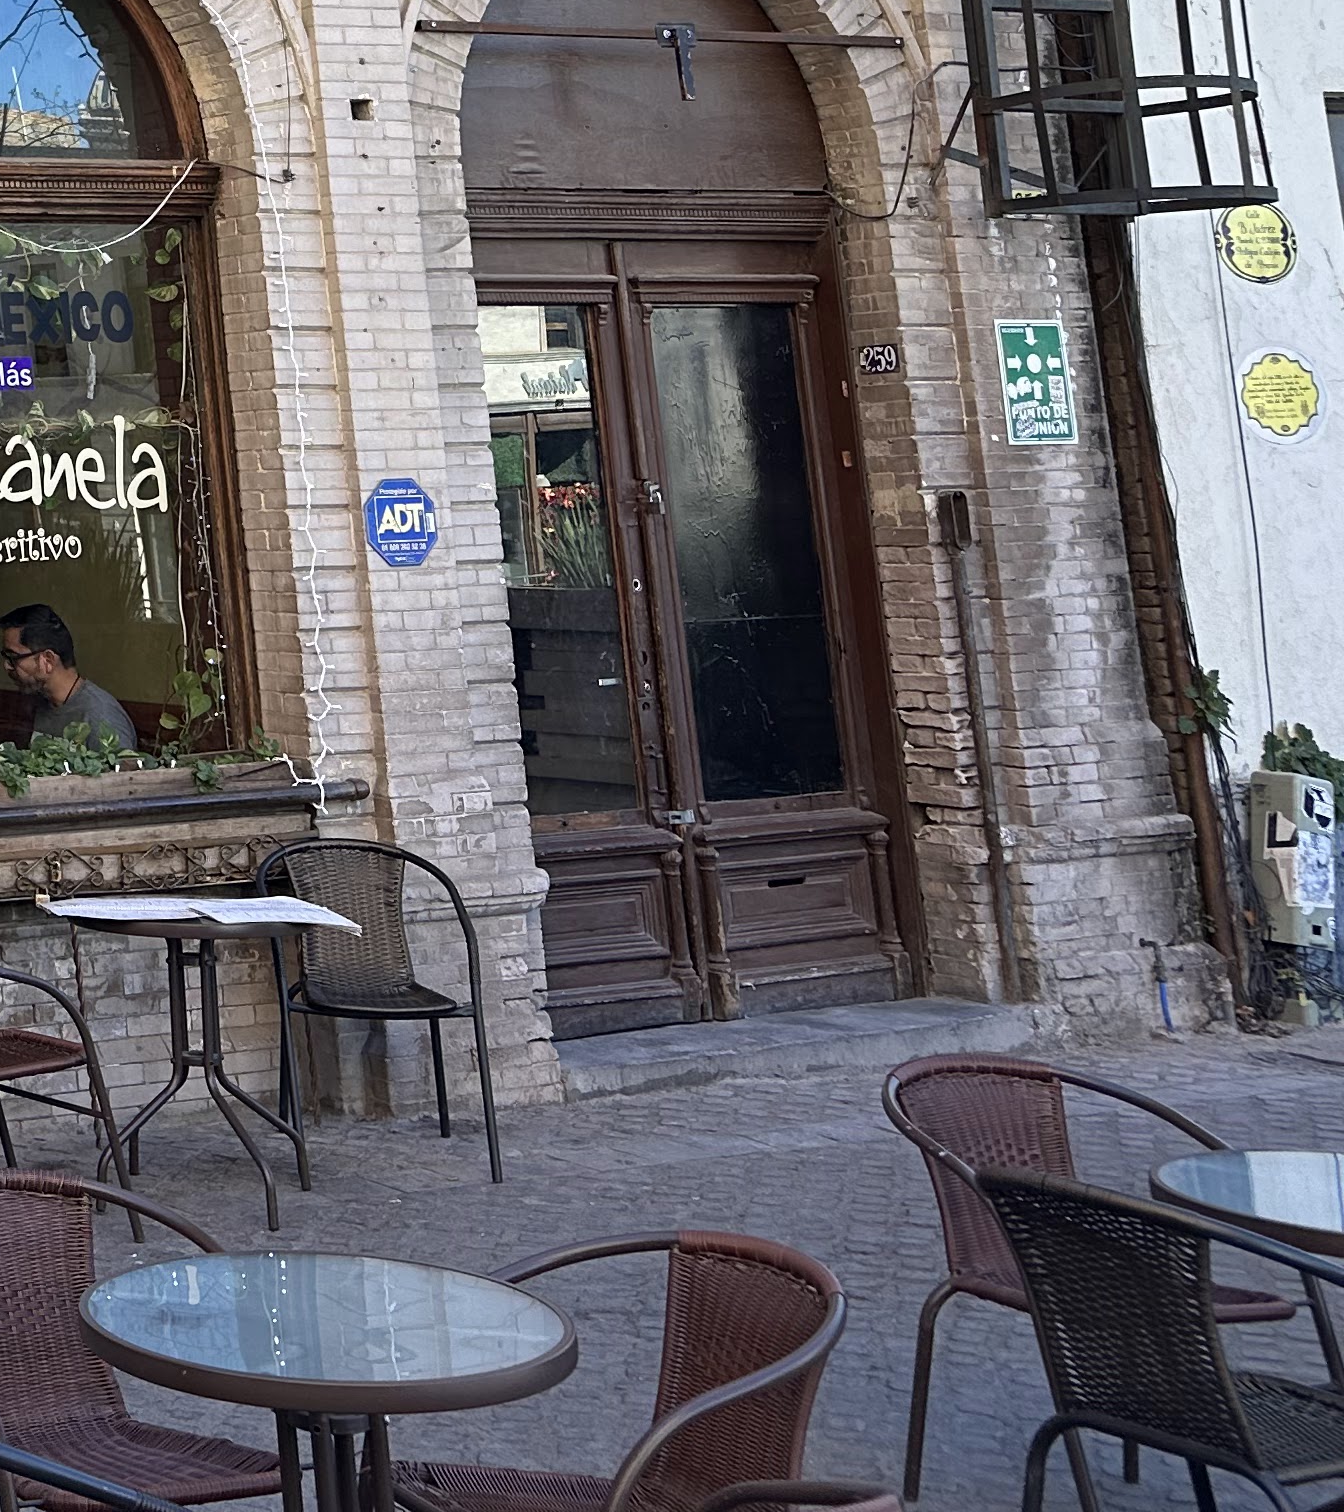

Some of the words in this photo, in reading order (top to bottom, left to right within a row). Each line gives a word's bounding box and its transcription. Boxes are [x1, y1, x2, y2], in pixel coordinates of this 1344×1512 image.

[863, 345, 897, 373] 259
[1012, 406, 1050, 419] PUNTO
[1052, 405, 1070, 419] DE
[378, 502, 424, 534] ADT
